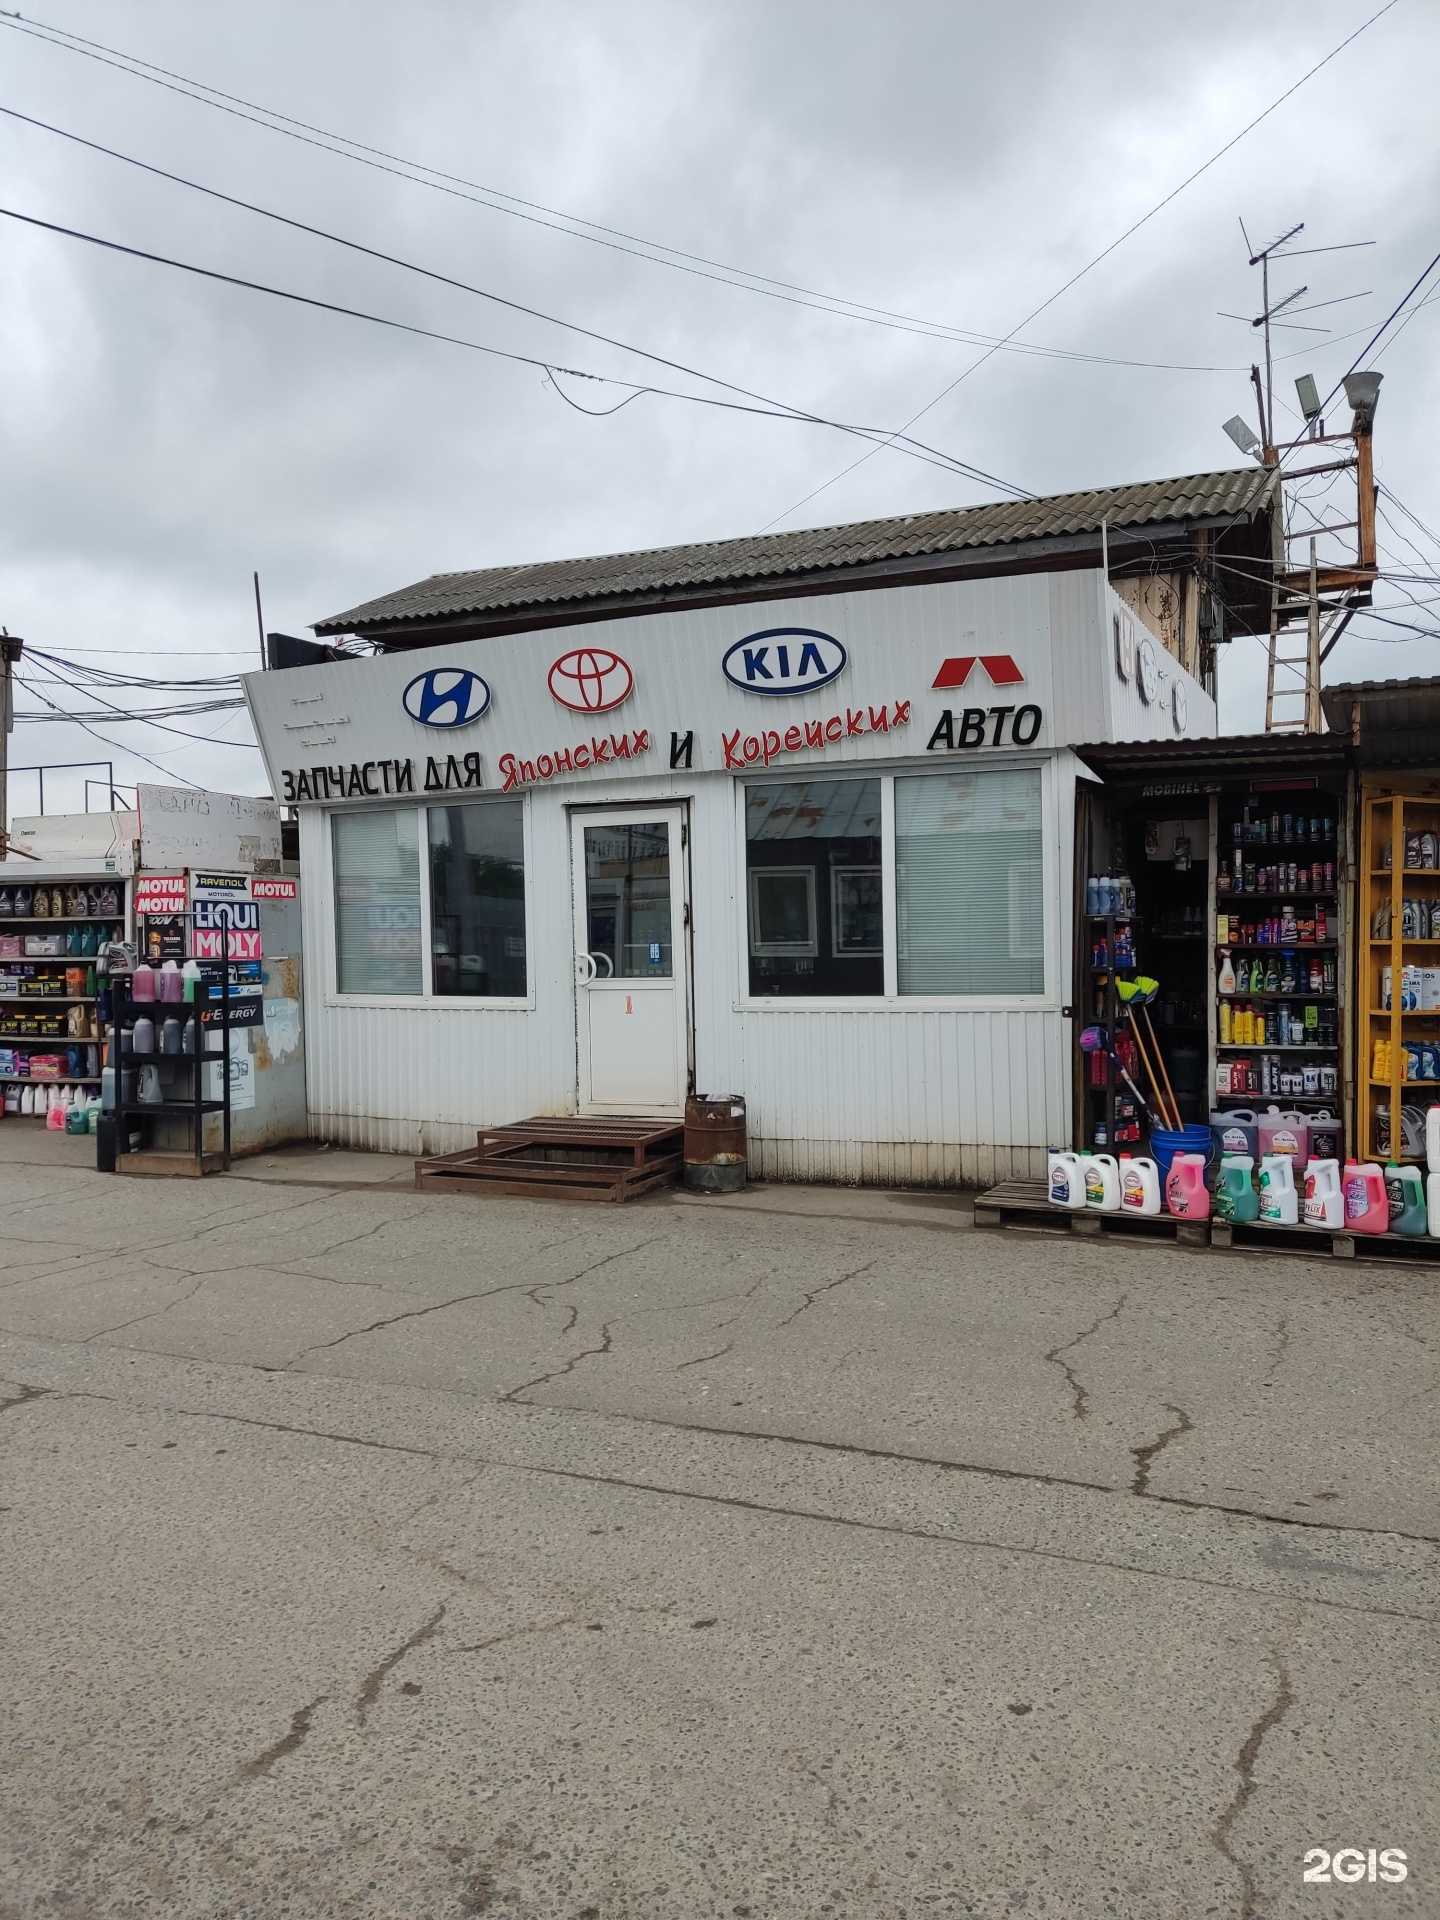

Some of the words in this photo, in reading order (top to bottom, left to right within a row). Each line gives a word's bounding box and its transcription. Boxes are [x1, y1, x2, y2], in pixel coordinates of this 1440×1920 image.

[742, 643, 828, 681] KIA
[281, 758, 413, 801] ЗАПЧАСТИ
[423, 751, 481, 791] ДЛЯ
[498, 728, 651, 793] Японских
[669, 730, 693, 769] И
[721, 700, 912, 770] Корейских
[926, 704, 1043, 751] АВТО
[137, 879, 186, 894] MOTUL
[200, 877, 243, 887] RAVENOL
[253, 883, 295, 897] MOTUL
[195, 902, 257, 929] LIQUI
[196, 932, 260, 957] MOLY
